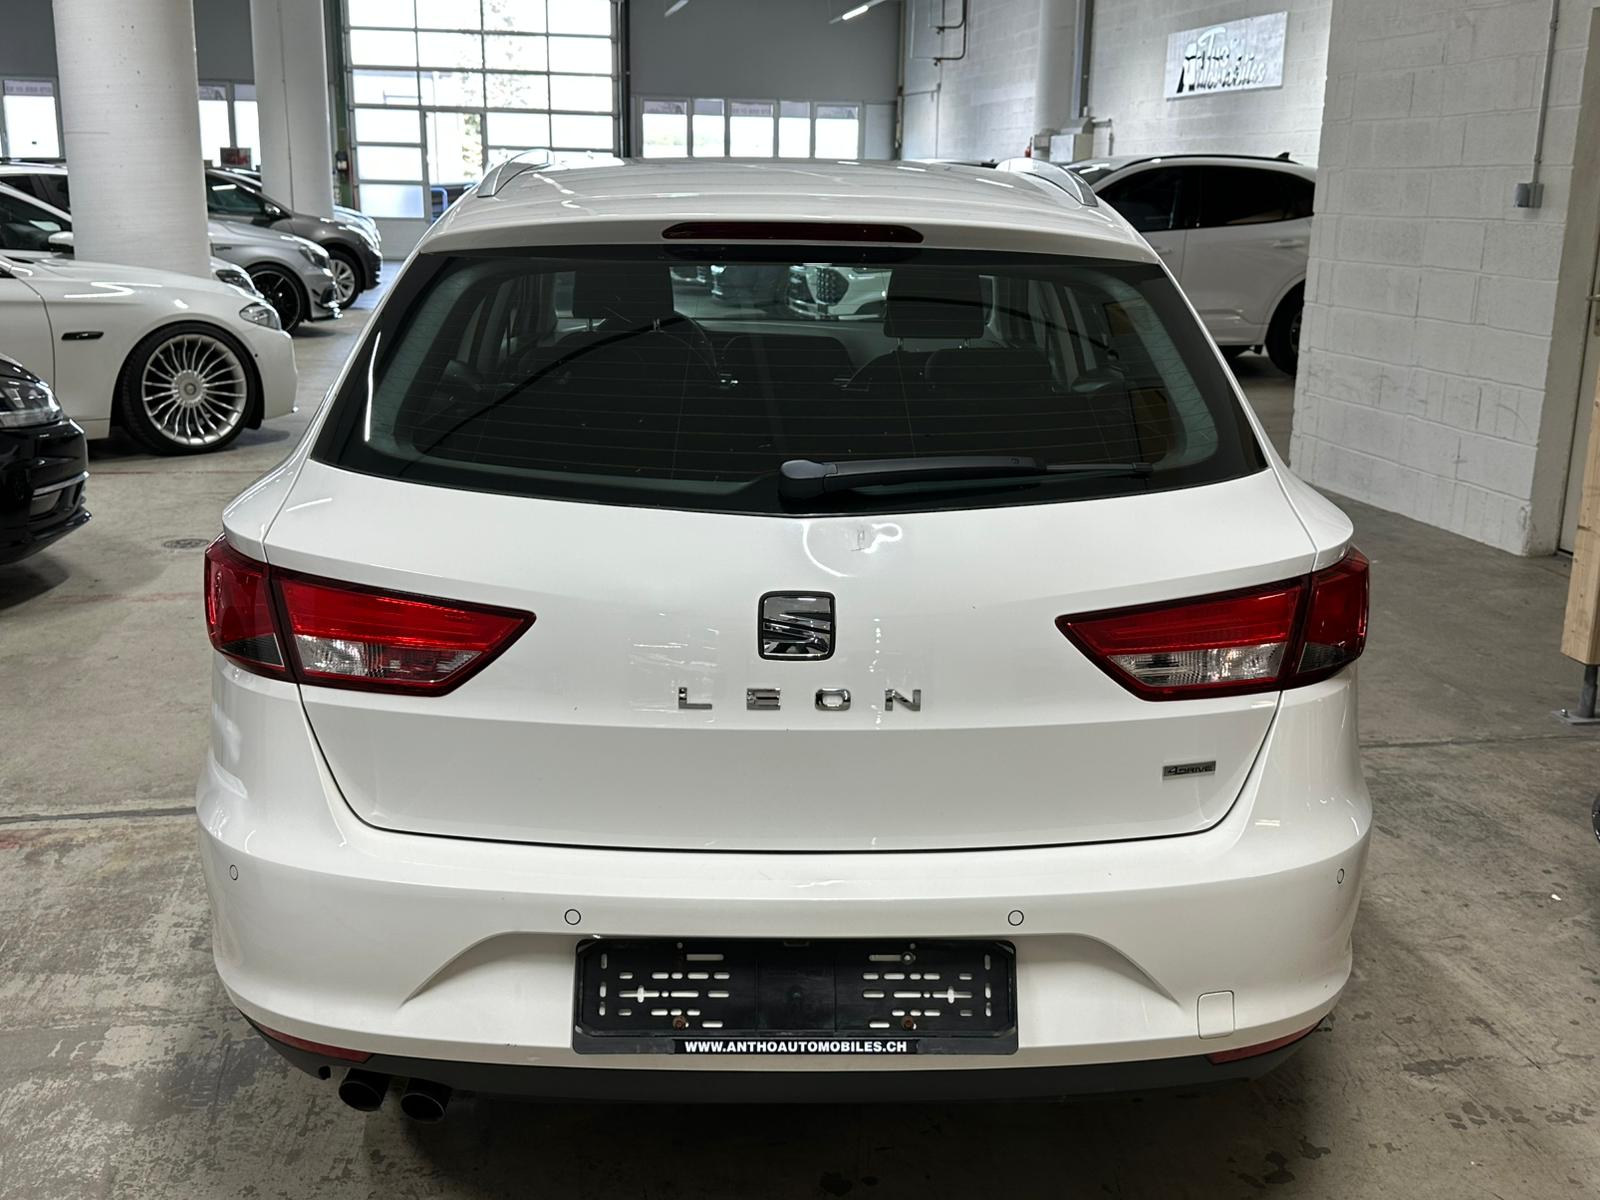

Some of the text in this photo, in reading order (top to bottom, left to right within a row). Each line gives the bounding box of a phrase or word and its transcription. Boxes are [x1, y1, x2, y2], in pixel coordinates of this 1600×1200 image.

[678, 687, 922, 712] LEON
[1166, 763, 1214, 776] 4DRIVE
[684, 1040, 908, 1053] WWW.ANTHOAUTOMOBILES.CH
